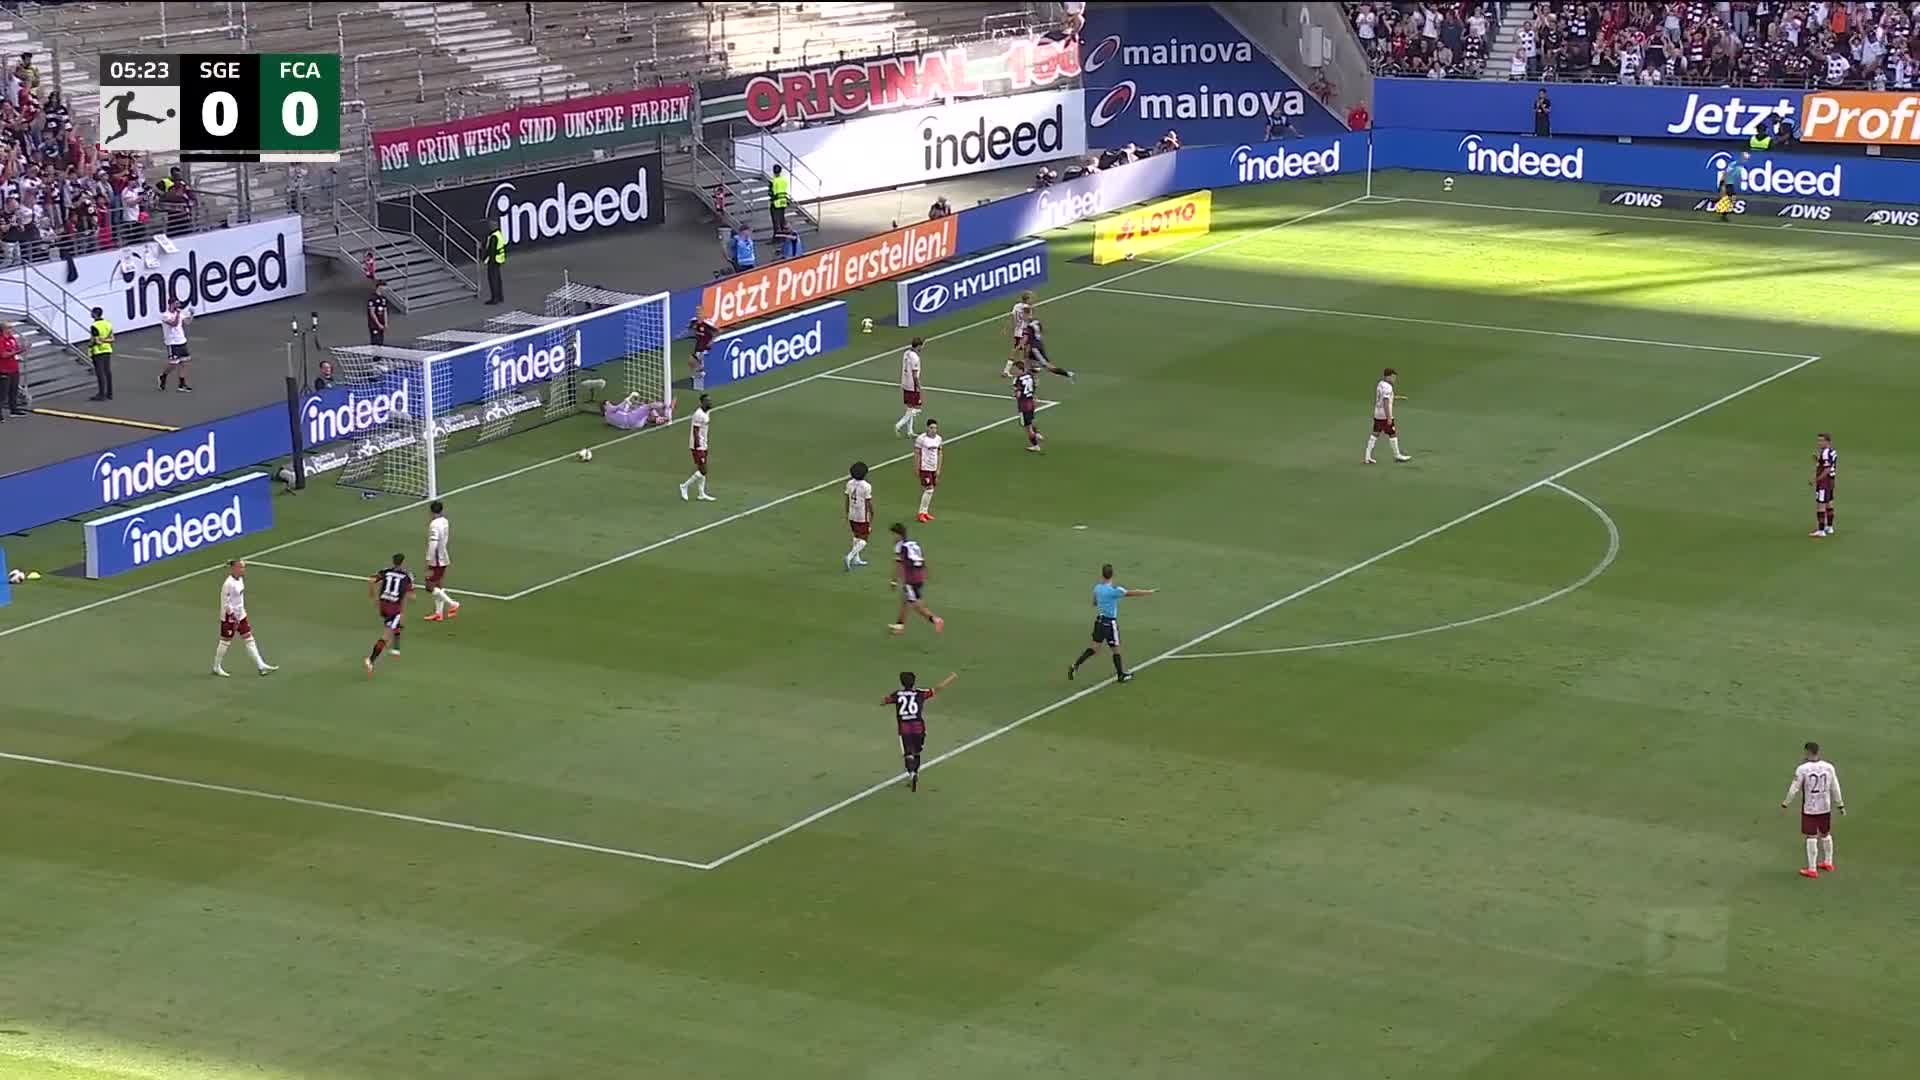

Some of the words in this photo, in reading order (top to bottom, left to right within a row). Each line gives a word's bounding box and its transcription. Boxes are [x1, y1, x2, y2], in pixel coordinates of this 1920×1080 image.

[1123, 38, 1252, 65] mainova
[745, 49, 982, 126] ORIGINAL
[1140, 85, 1304, 119] mainova
[380, 142, 409, 171] ROT
[417, 130, 460, 167] GRÜN
[463, 122, 511, 158] WEISS
[519, 116, 557, 145] SIND
[564, 106, 625, 138] UNSERE
[631, 95, 690, 129] FARBEN
[918, 104, 1062, 170] indeed
[1230, 141, 1340, 182] indeed
[1458, 134, 1583, 179] indeed
[485, 167, 648, 243] indeed
[1140, 202, 1196, 236] LOTTO
[1624, 192, 1663, 207] DWS
[1790, 204, 1832, 220] DWS
[1881, 210, 1919, 226] DWS
[110, 233, 287, 320] indeed
[711, 278, 770, 323] Jetzt
[776, 254, 841, 306] Profil
[845, 221, 949, 284] erstellen!
[953, 255, 1041, 300] HYUNDAI
[724, 321, 822, 379] indeed
[301, 377, 409, 444] indeed
[92, 431, 216, 503] indeed
[122, 495, 243, 565] indeed
[384, 575, 401, 596] 11
[897, 695, 918, 715] 26
